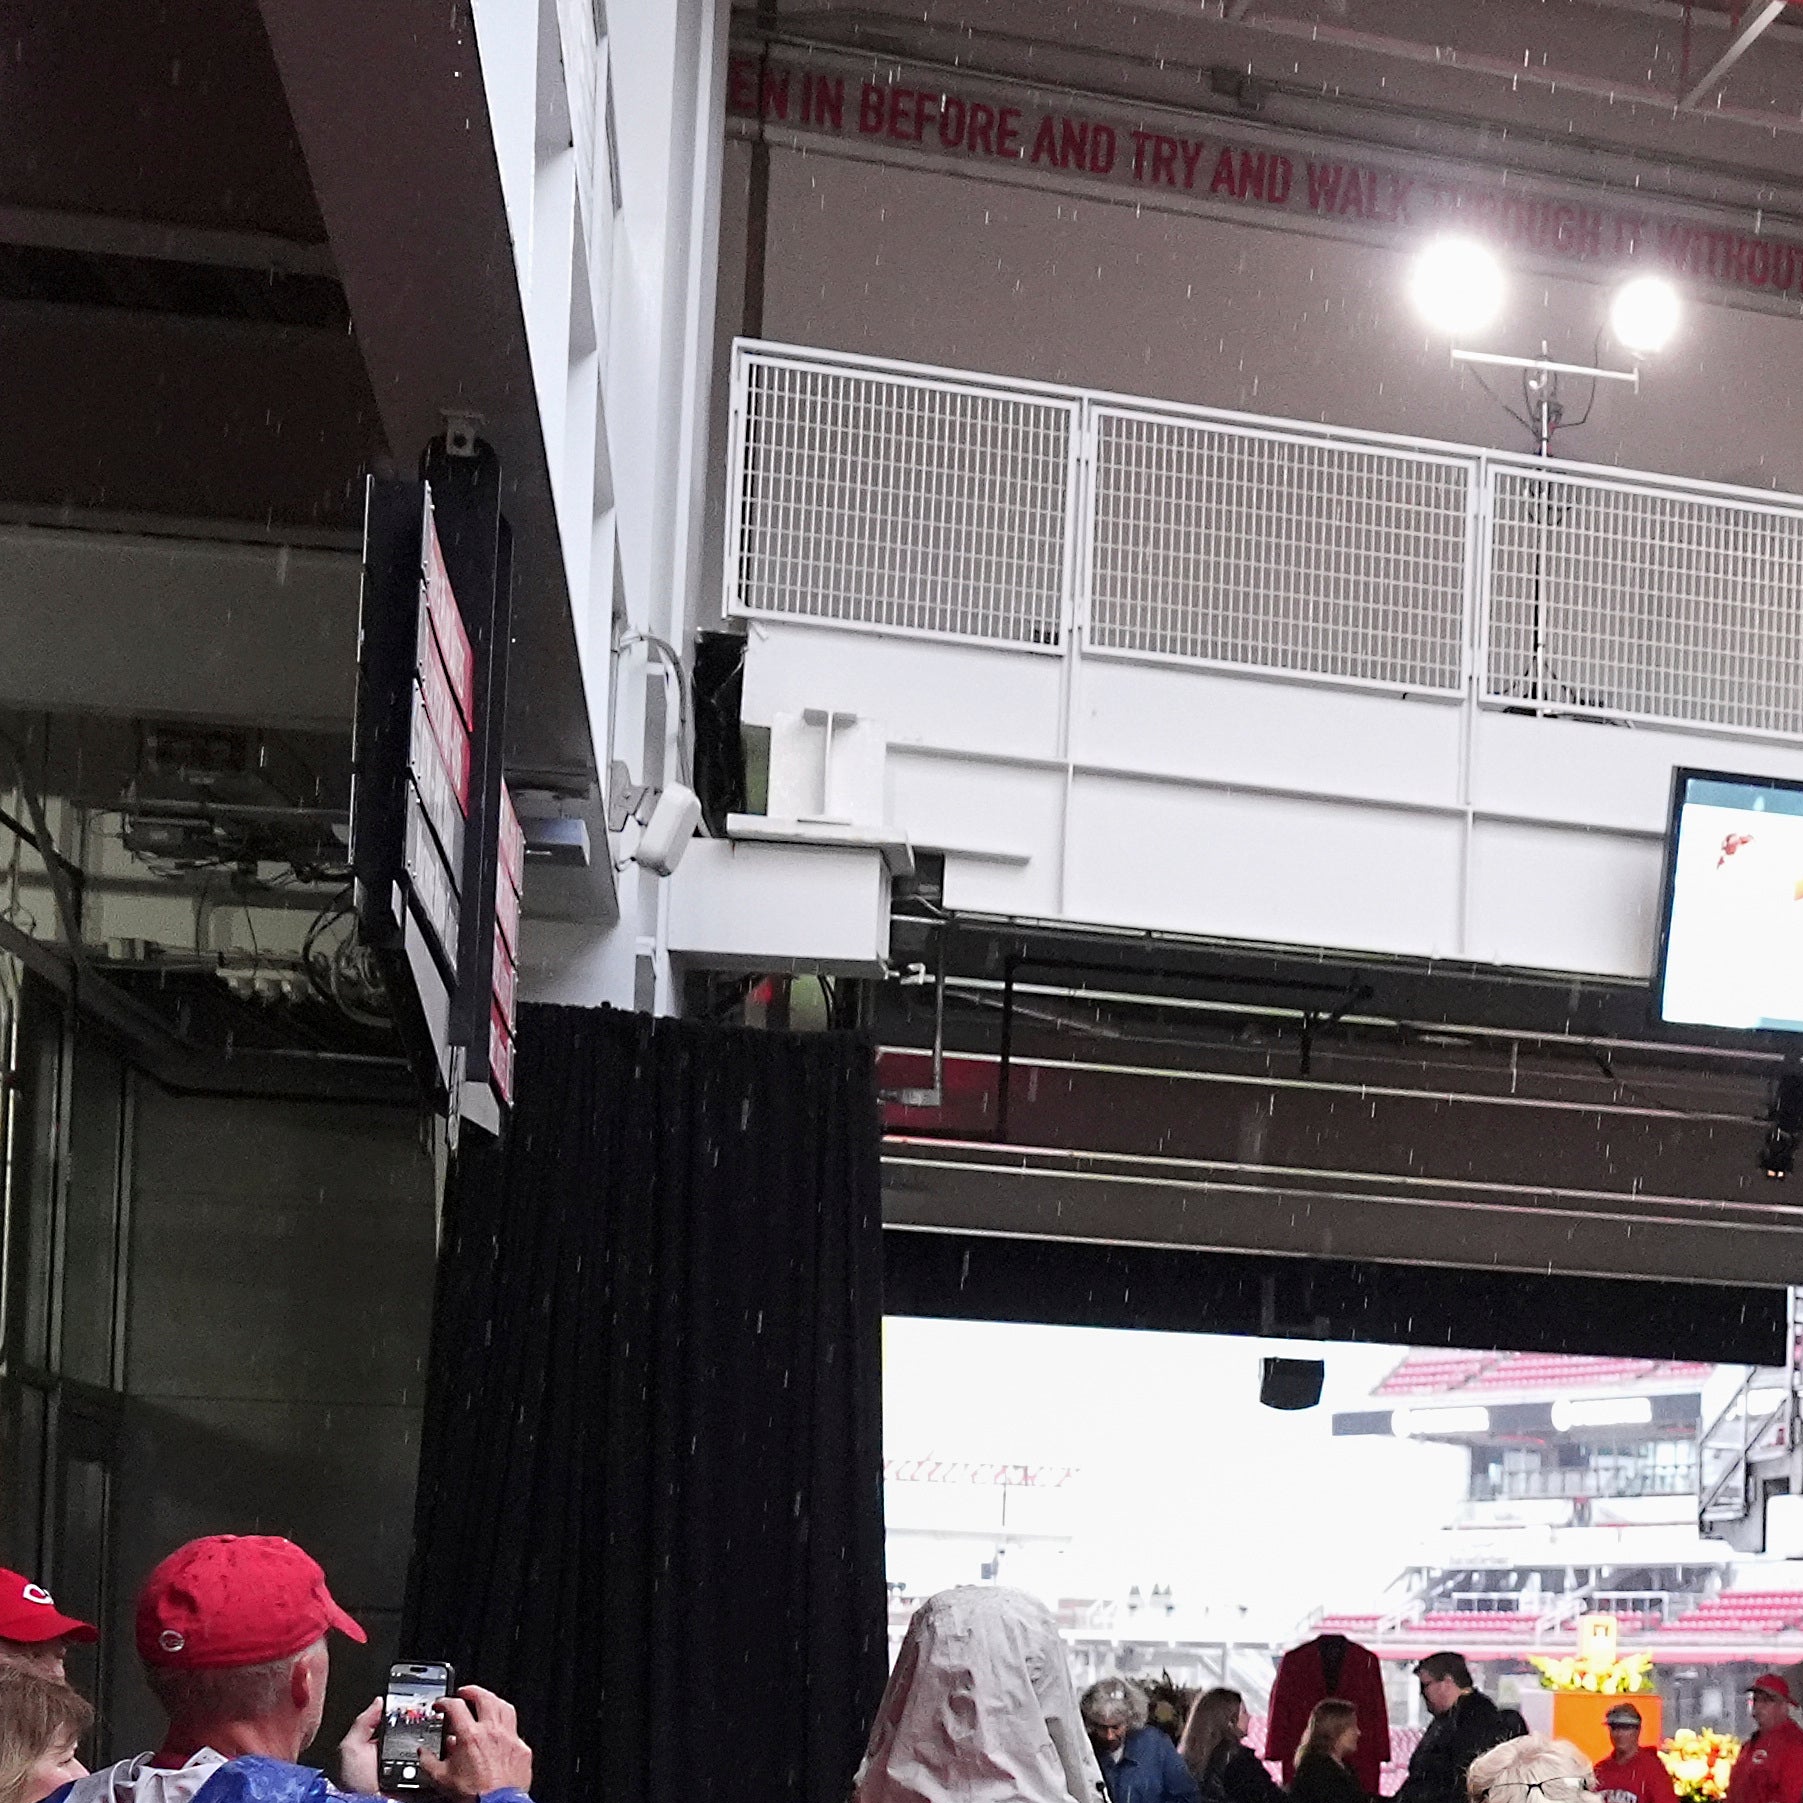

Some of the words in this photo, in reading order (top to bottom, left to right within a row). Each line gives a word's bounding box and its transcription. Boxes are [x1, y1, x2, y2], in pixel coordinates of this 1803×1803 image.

[801, 74, 845, 129] IN
[859, 81, 1023, 160] BEFORE
[1030, 115, 1117, 175] AND
[1132, 129, 1203, 190] TRY
[1210, 150, 1294, 204] AND
